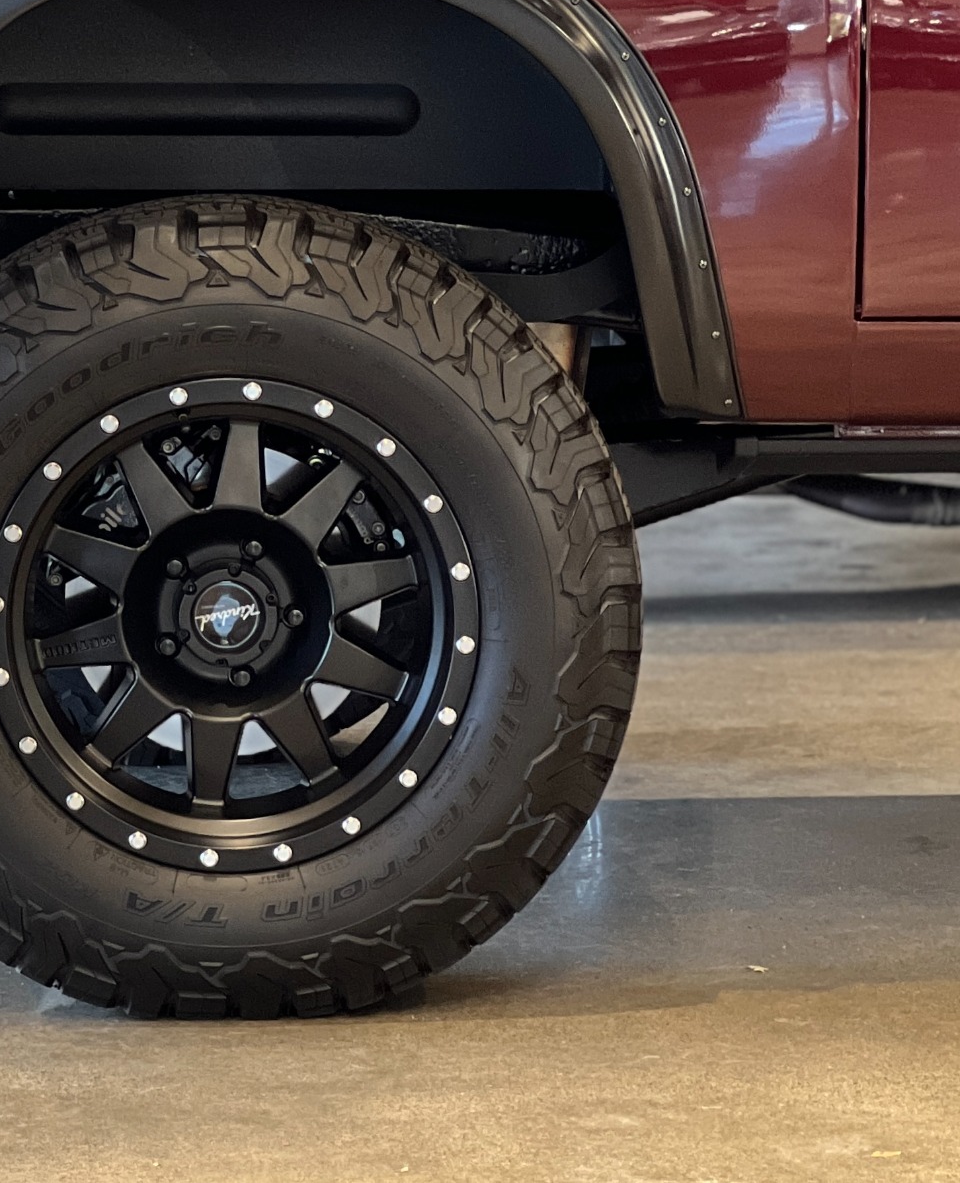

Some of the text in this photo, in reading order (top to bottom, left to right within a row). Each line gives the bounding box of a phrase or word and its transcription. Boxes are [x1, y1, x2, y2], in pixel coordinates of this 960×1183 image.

[195, 603, 260, 632] Kindred
[42, 634, 117, 658] METHOD
[262, 667, 531, 922] All-Terrain
[124, 890, 228, 928] T/A
